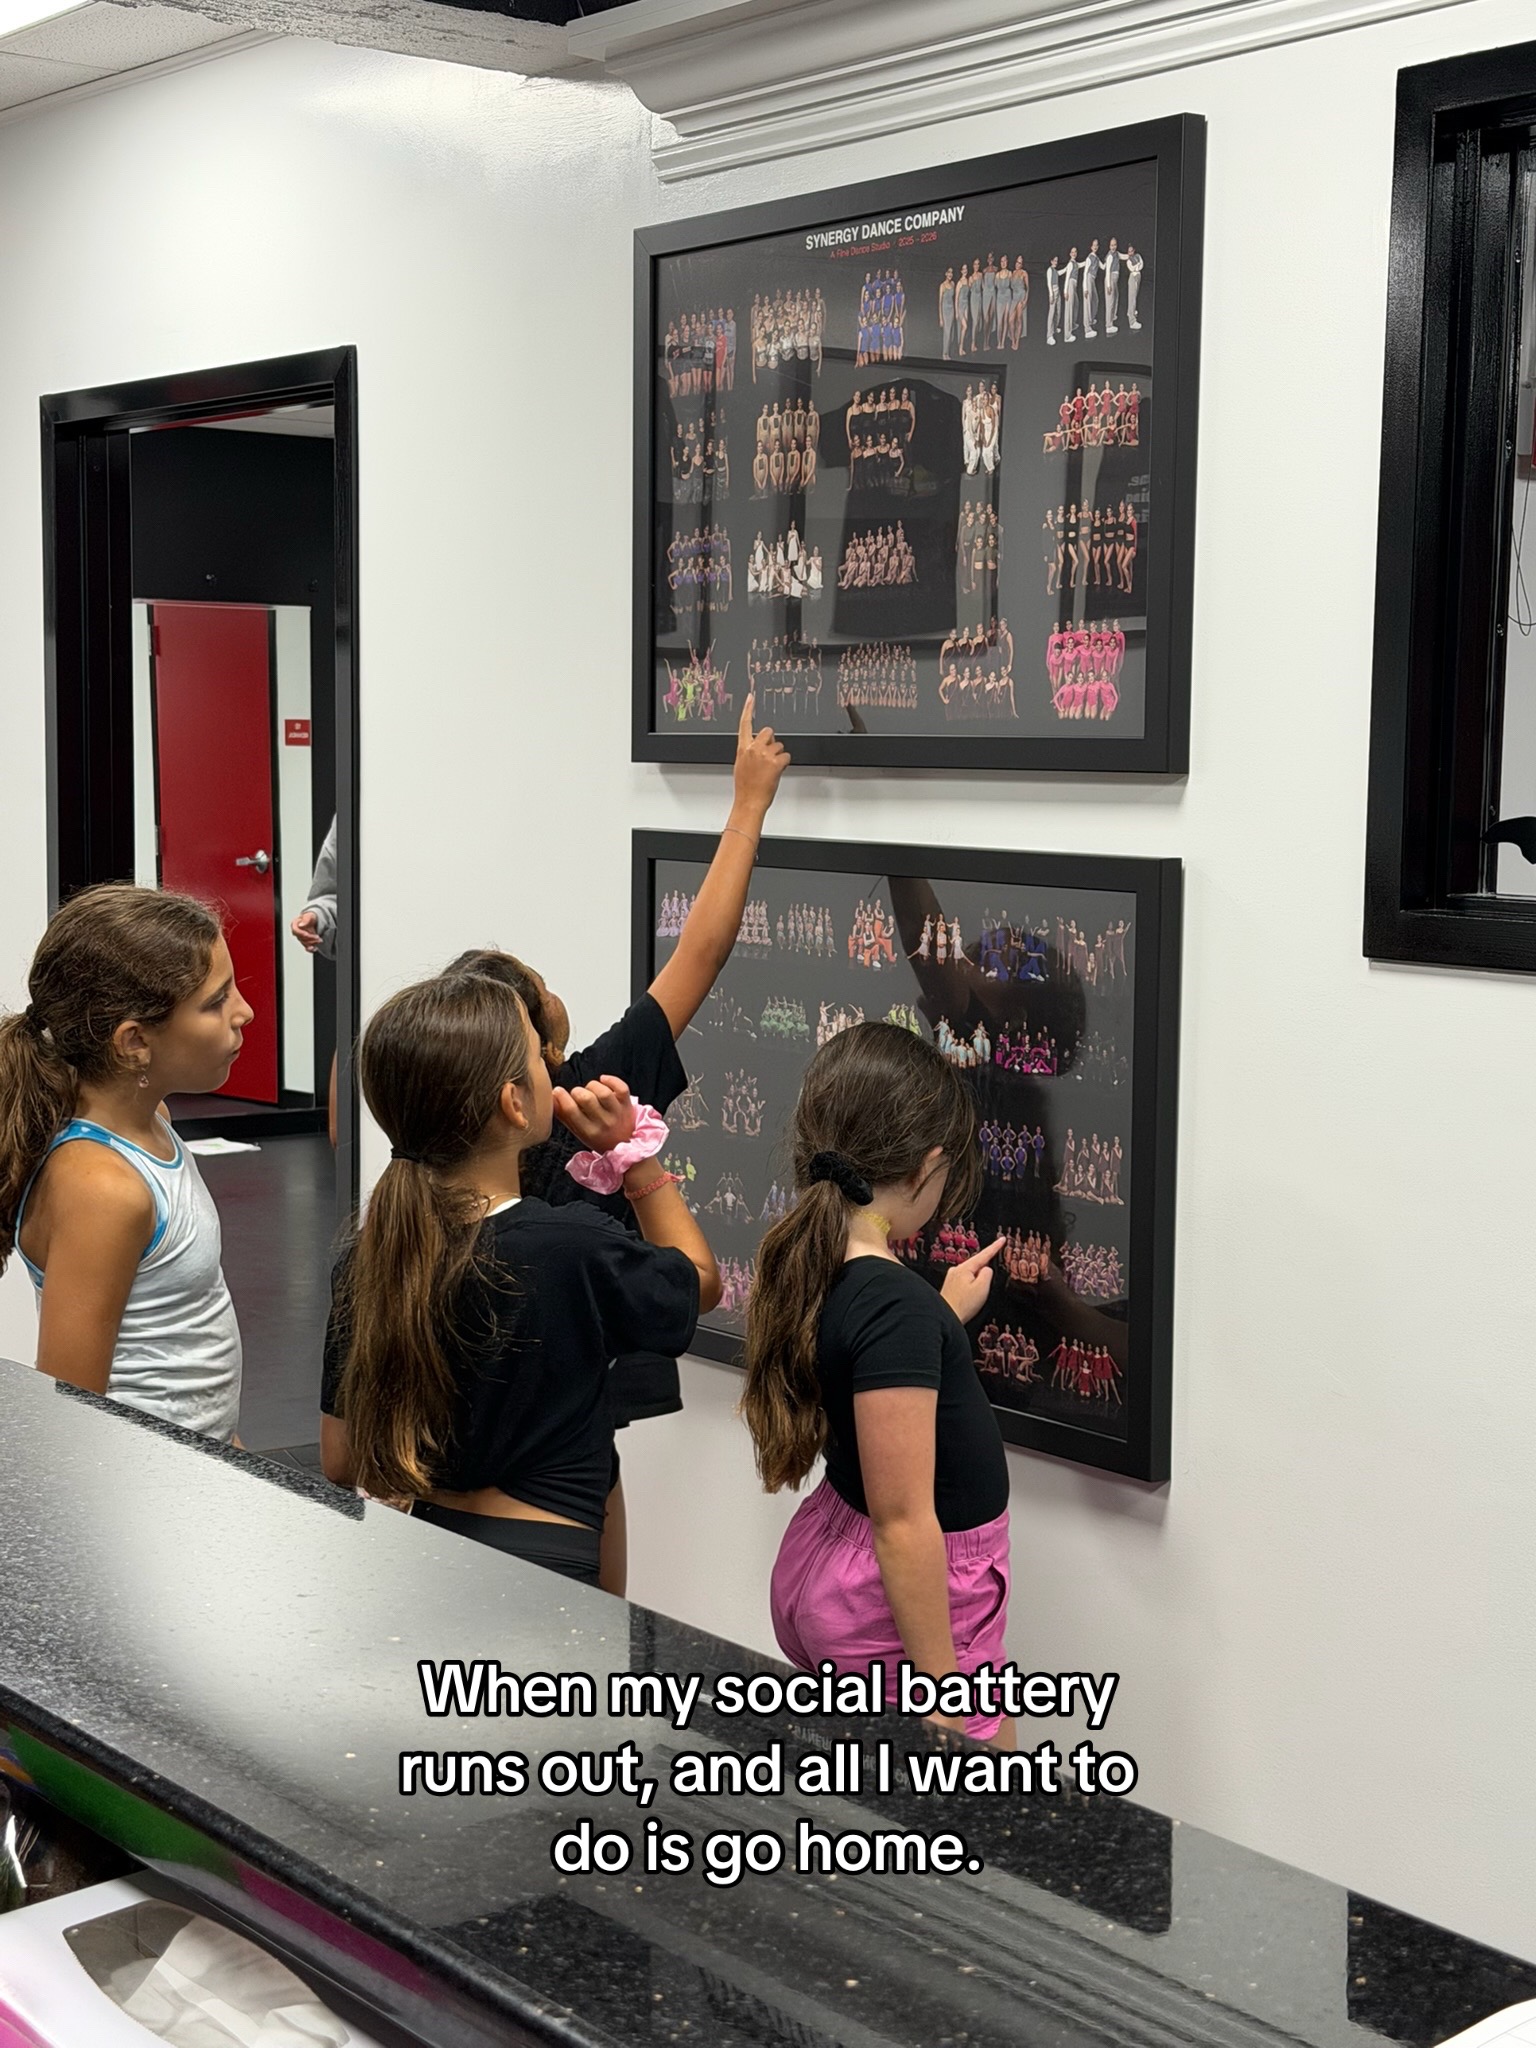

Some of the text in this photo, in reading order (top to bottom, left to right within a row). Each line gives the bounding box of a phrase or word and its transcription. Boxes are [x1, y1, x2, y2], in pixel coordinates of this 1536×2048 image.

[805, 205, 965, 250] SYNERGY DANCE COMPANY
[830, 250, 836, 259] A
[850, 245, 871, 256] Dance
[871, 241, 891, 252] Studio
